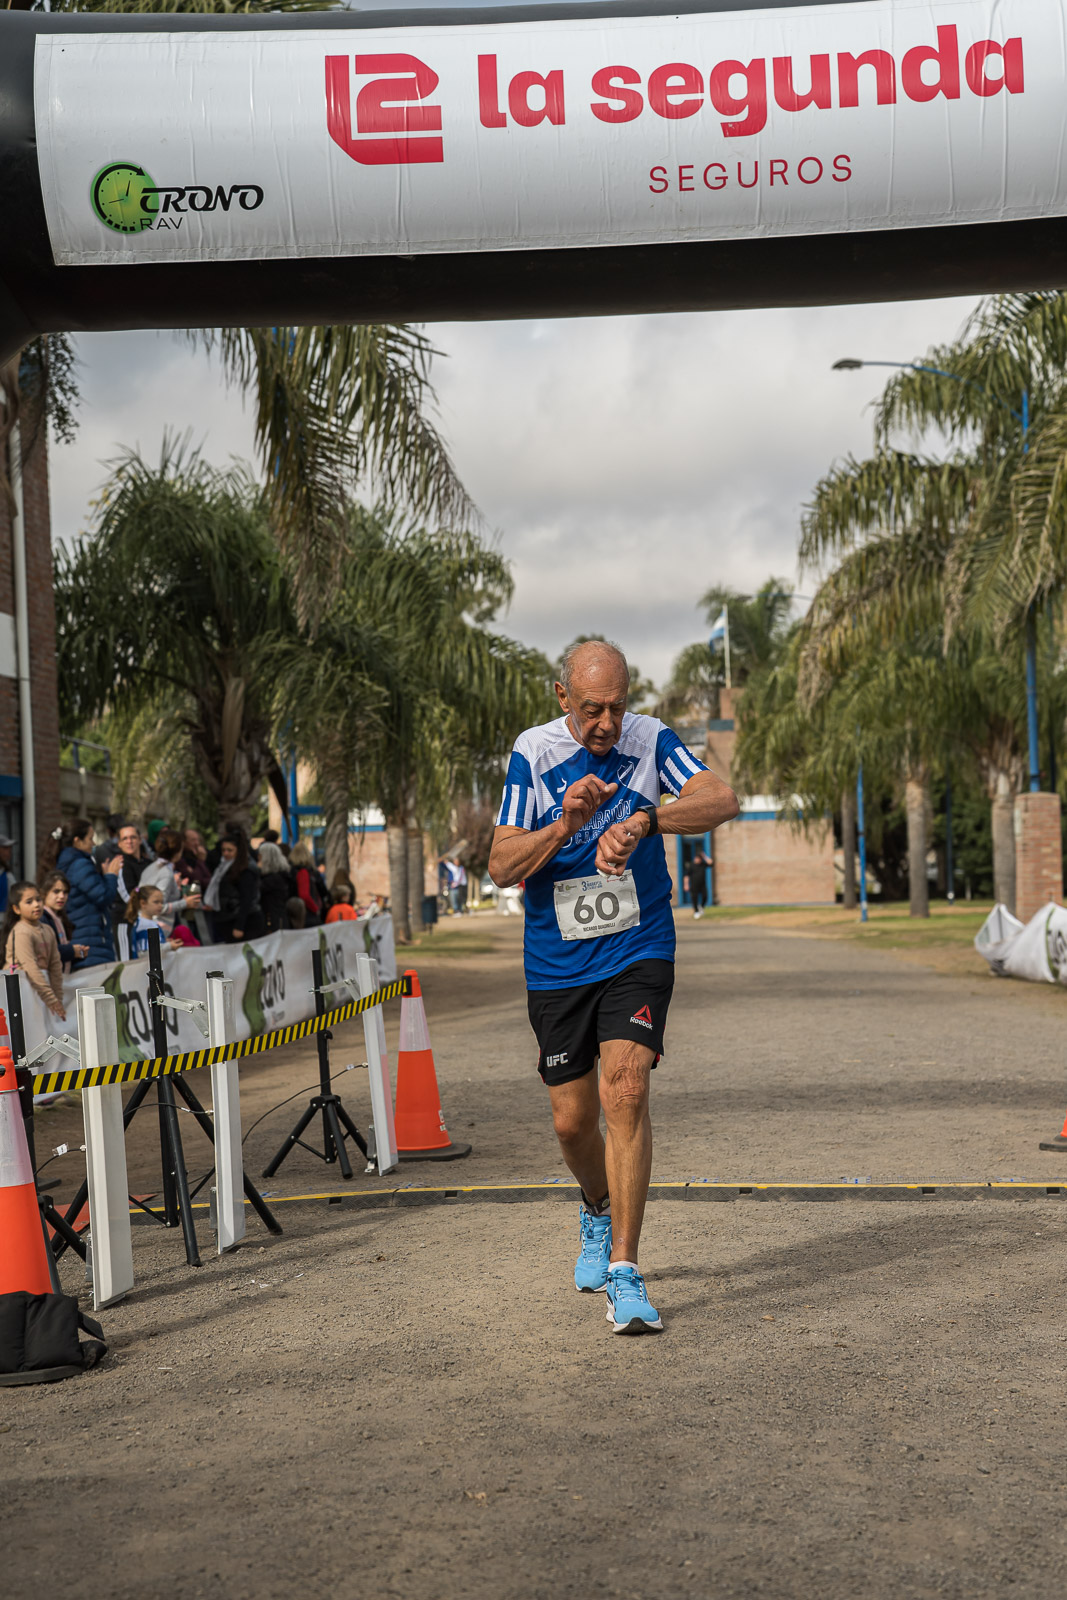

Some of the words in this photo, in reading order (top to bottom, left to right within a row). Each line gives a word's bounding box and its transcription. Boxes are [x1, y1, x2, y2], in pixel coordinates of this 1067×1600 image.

[477, 54, 566, 129] la
[590, 24, 1025, 138] segunda
[649, 154, 852, 194] SEGUROS
[140, 184, 264, 212] CRONO
[139, 216, 183, 231] RAV
[573, 891, 620, 925] 60
[629, 1016, 654, 1031] Reebok
[546, 1052, 569, 1068] UFC
